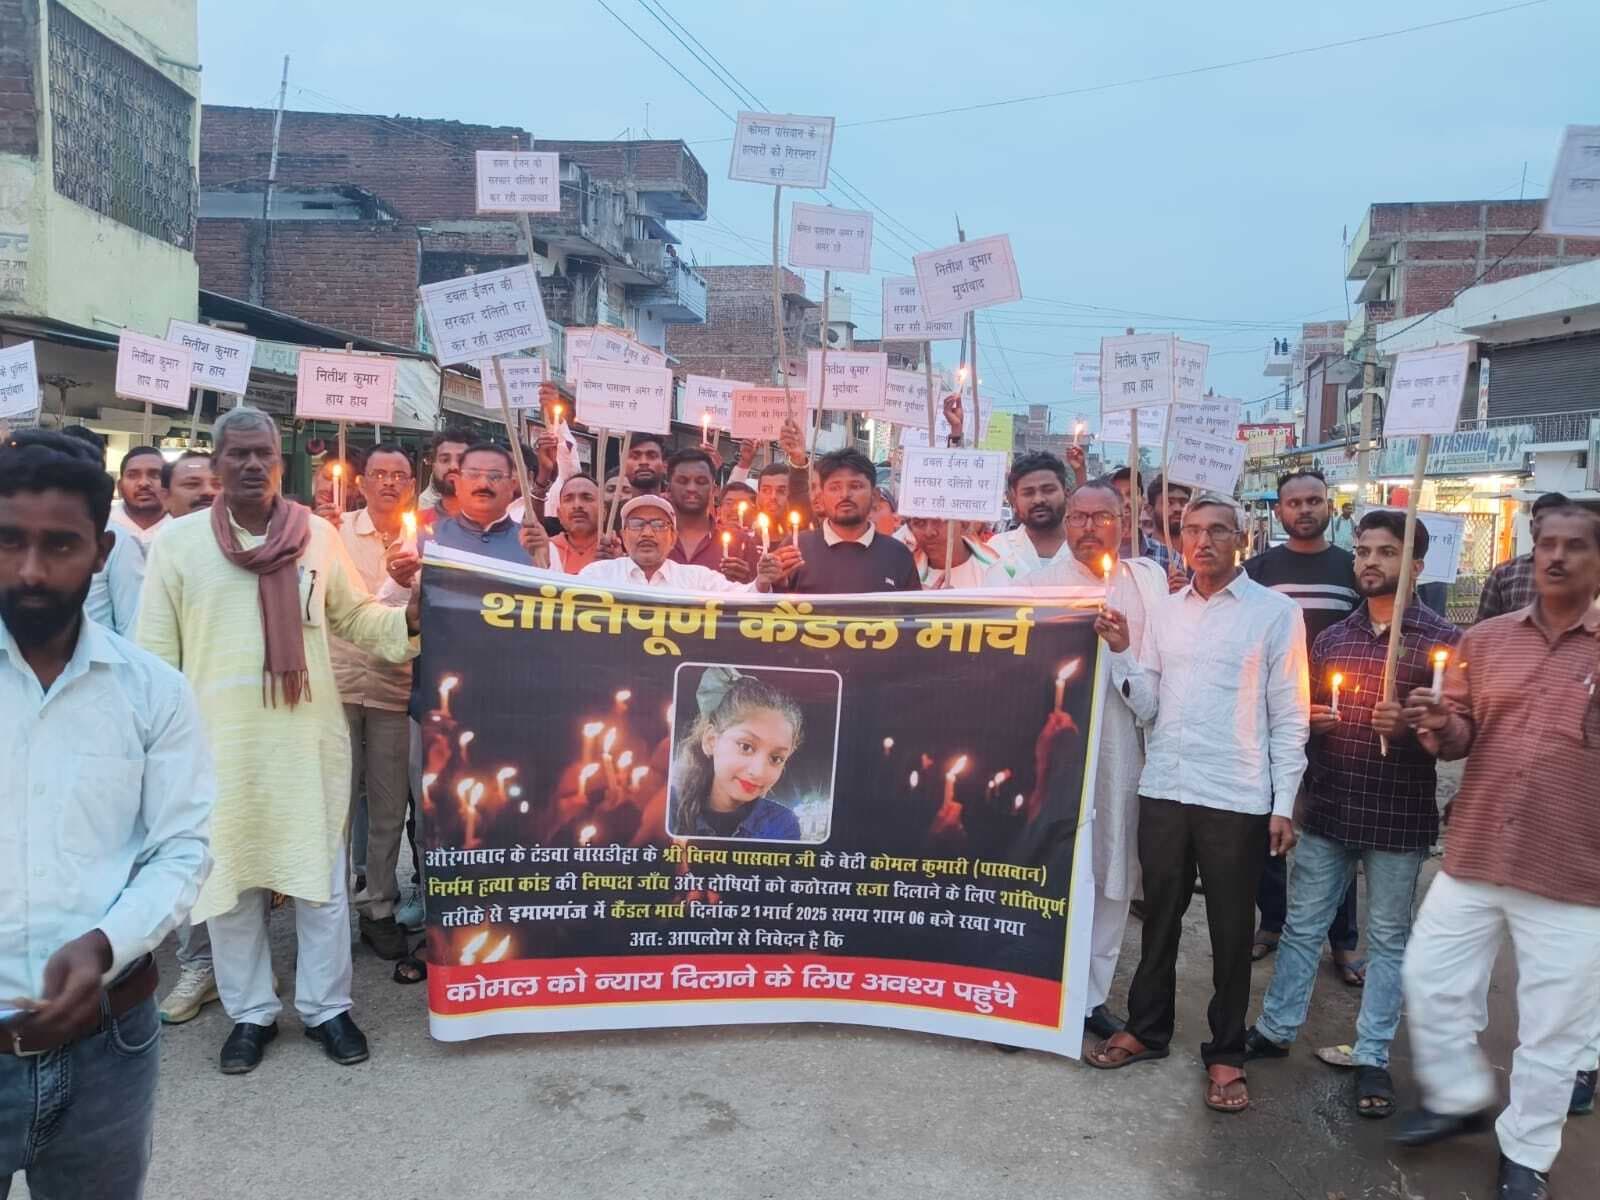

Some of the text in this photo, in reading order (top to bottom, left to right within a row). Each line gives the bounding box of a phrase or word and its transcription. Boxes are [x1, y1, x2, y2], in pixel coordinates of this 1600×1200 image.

[935, 252, 993, 277] नितीश कुमार
[214, 343, 241, 360] कुमार
[1141, 351, 1161, 370] कुमार
[316, 366, 381, 389] नितीश कुमार
[326, 393, 369, 408] हाय हाय
[1440, 431, 1491, 454] FASHION
[480, 585, 1036, 656] शांतिपूर्ण कैंडल मार्च
[425, 847, 507, 867] औरंगाबाद
[510, 844, 526, 862] के
[531, 844, 569, 862] टंडवा
[573, 843, 639, 865] बांसडीहा
[643, 844, 659, 862] के
[663, 846, 683, 863] श्री
[732, 850, 792, 868] पासवान
[795, 849, 817, 868] जी
[819, 851, 835, 869] के
[839, 851, 867, 870] बेटी
[869, 852, 919, 873] कोमल
[921, 856, 969, 879] कुमारी
[973, 858, 1048, 888] (पासवान)
[428, 875, 473, 897] निर्मम
[478, 875, 515, 897] हत्या
[518, 871, 552, 892] कांड
[555, 871, 578, 891] की
[581, 870, 635, 891] निष्पक्ष
[674, 871, 704, 892] और
[708, 873, 761, 893] दोषियों
[765, 875, 787, 894] को
[790, 876, 853, 897] कठोरतम
[856, 881, 890, 898] सजा
[893, 880, 942, 901] दिलाने
[945, 884, 960, 901] के
[964, 883, 997, 905] लिए
[999, 889, 1066, 920] शांतिपूर्ण
[441, 905, 487, 928] तरीके
[489, 904, 504, 924] से
[508, 900, 588, 923] इमामगंज
[592, 901, 606, 919] में
[610, 899, 650, 919] कैंडल
[654, 900, 687, 919] मार्च
[689, 900, 739, 919] दिनांक
[795, 906, 828, 922] 2025
[832, 907, 869, 923] समय
[872, 908, 907, 925] शाम
[908, 910, 925, 926] 06
[929, 909, 955, 928] बजे
[958, 914, 991, 932] रखा
[993, 918, 1027, 937] गया
[667, 928, 735, 947] आपलोग
[737, 928, 751, 946] से
[755, 928, 807, 948] निवेदन
[808, 930, 822, 950] है
[823, 930, 845, 949] कि
[446, 963, 1018, 1013] कोमल को न्याय दिलाने के लिए अवश्य पहुंचे
